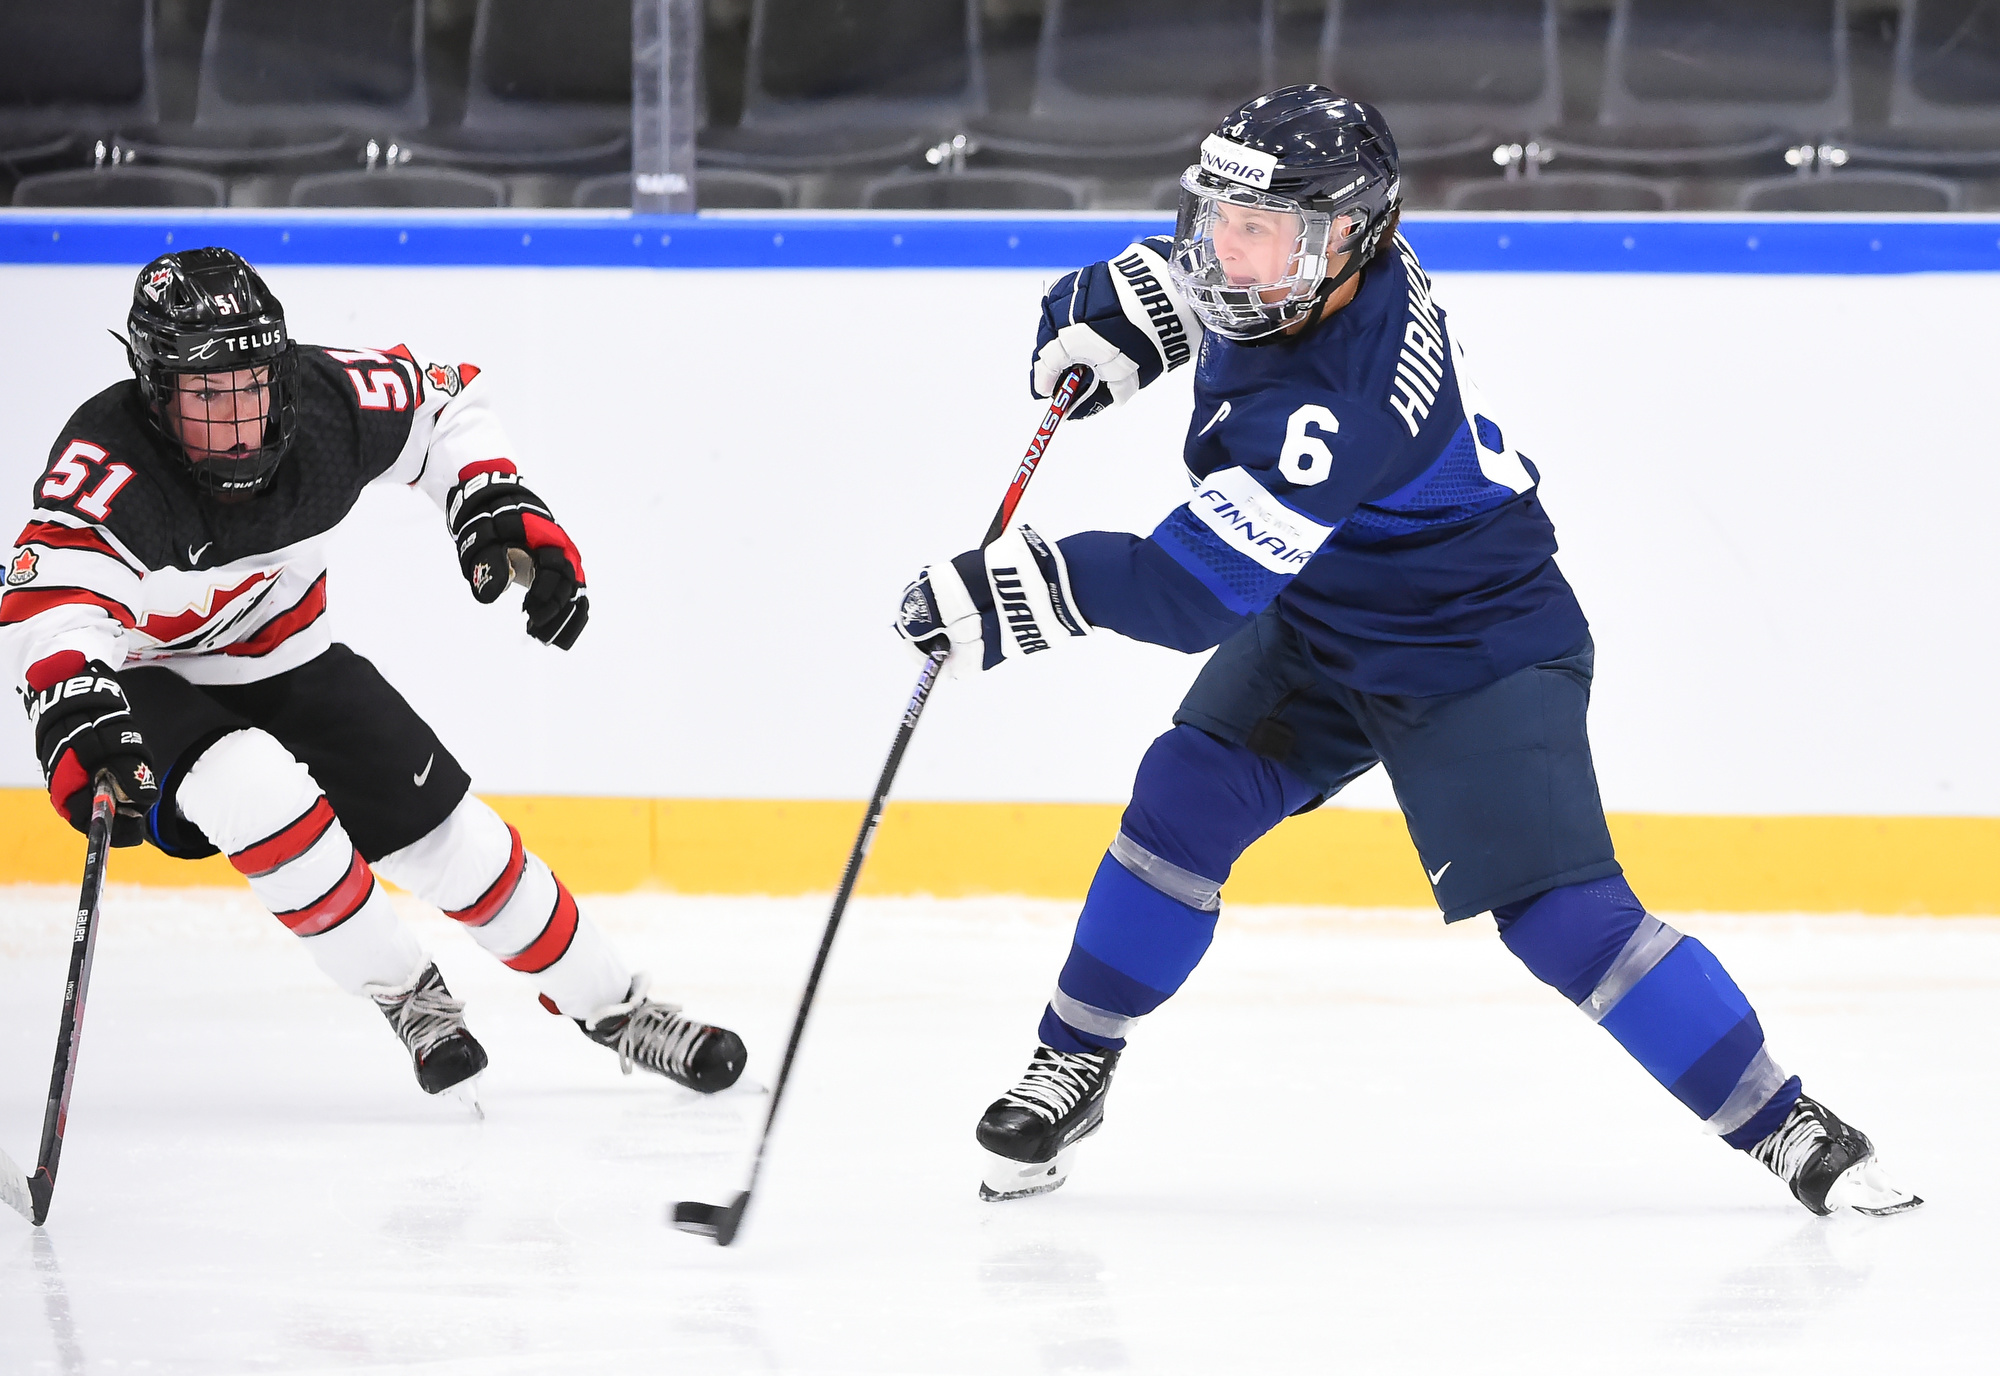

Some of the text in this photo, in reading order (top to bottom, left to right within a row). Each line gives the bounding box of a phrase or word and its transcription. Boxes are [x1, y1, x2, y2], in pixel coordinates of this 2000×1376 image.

[213, 293, 241, 316] 51
[225, 330, 281, 353] TELUS
[1277, 403, 1340, 487] 6
[40, 439, 137, 522] 51
[1200, 489, 1314, 564] FINNAIR
[74, 909, 88, 943] BAUER
